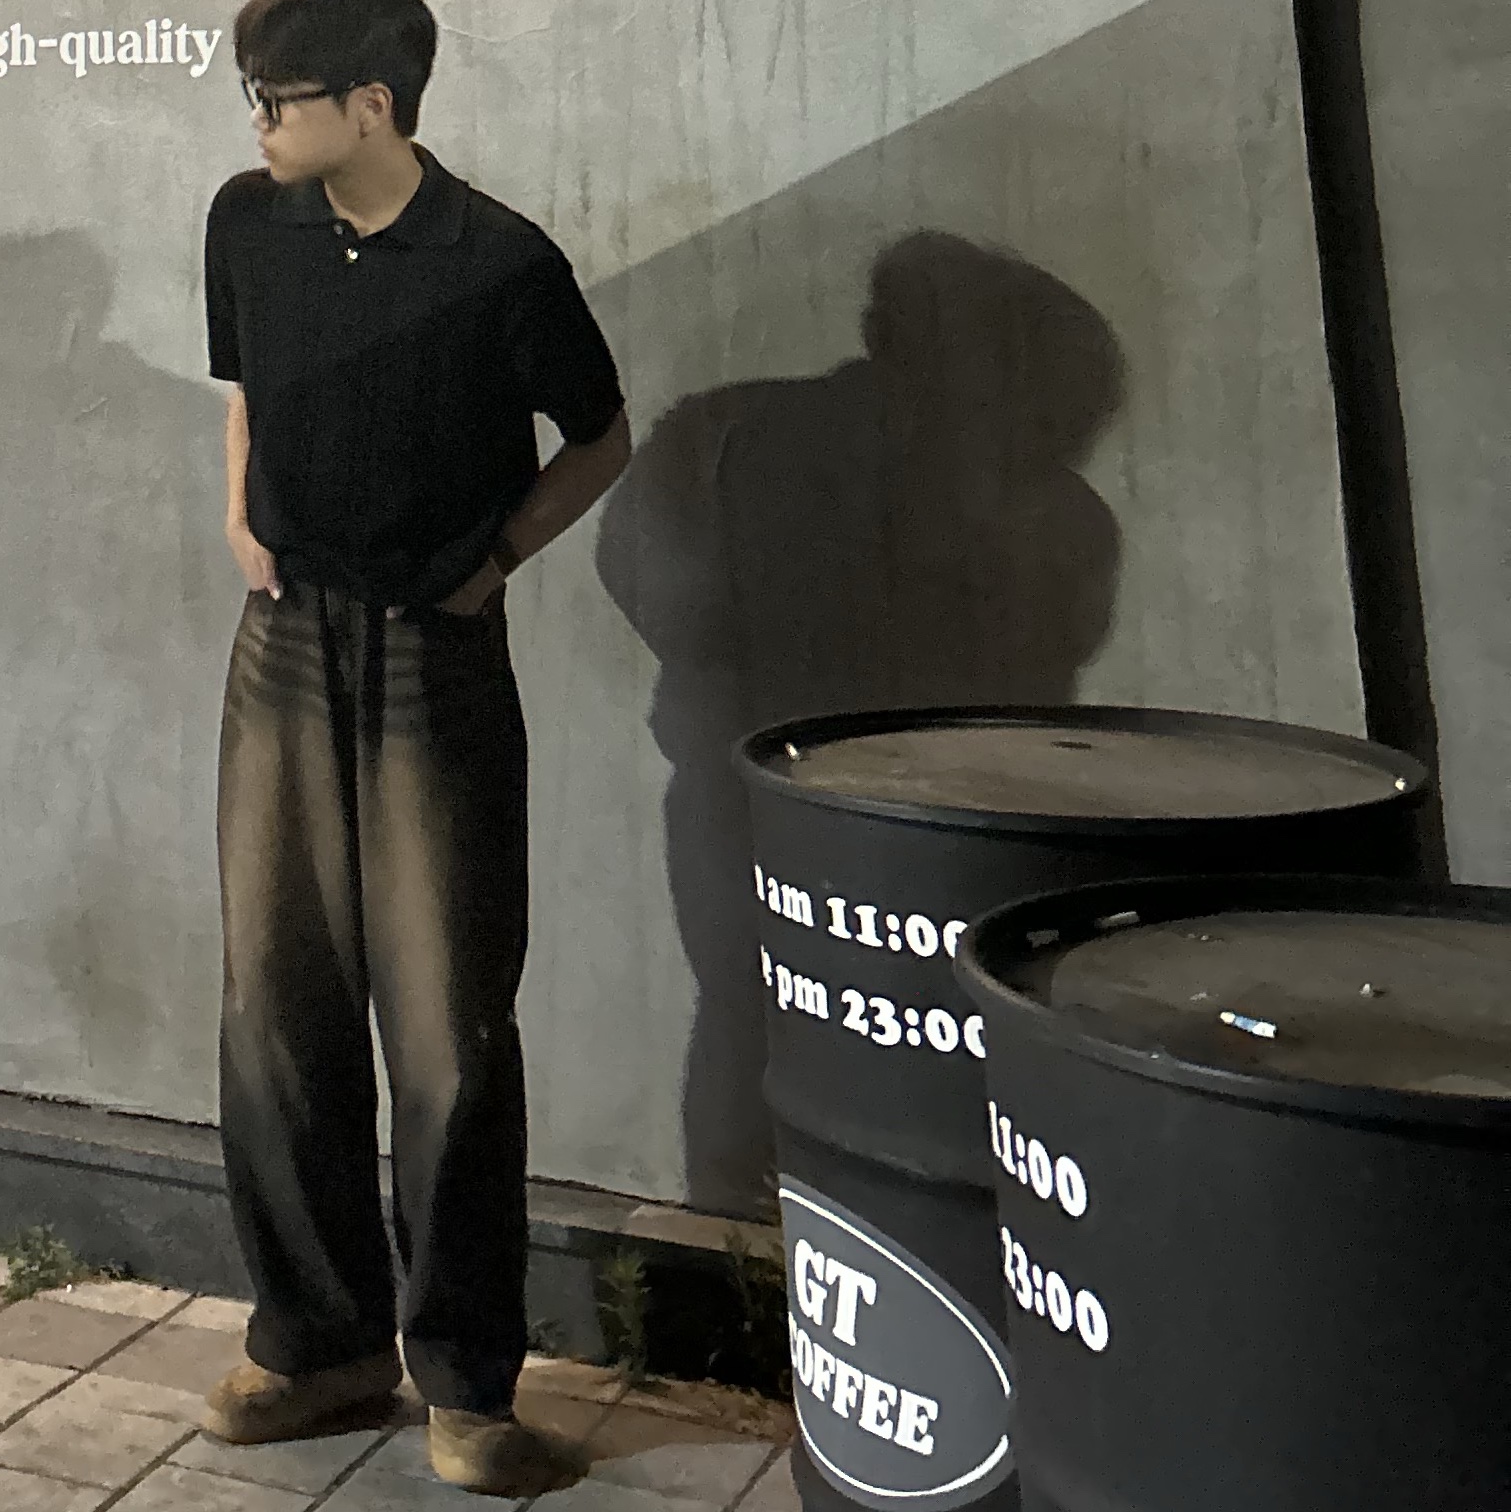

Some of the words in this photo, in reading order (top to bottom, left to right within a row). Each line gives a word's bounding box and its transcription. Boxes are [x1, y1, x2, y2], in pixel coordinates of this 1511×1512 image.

[767, 877, 815, 928] am
[775, 964, 830, 1020] pm
[794, 1238, 877, 1347] GT
[788, 1311, 939, 1456] COFFEE
